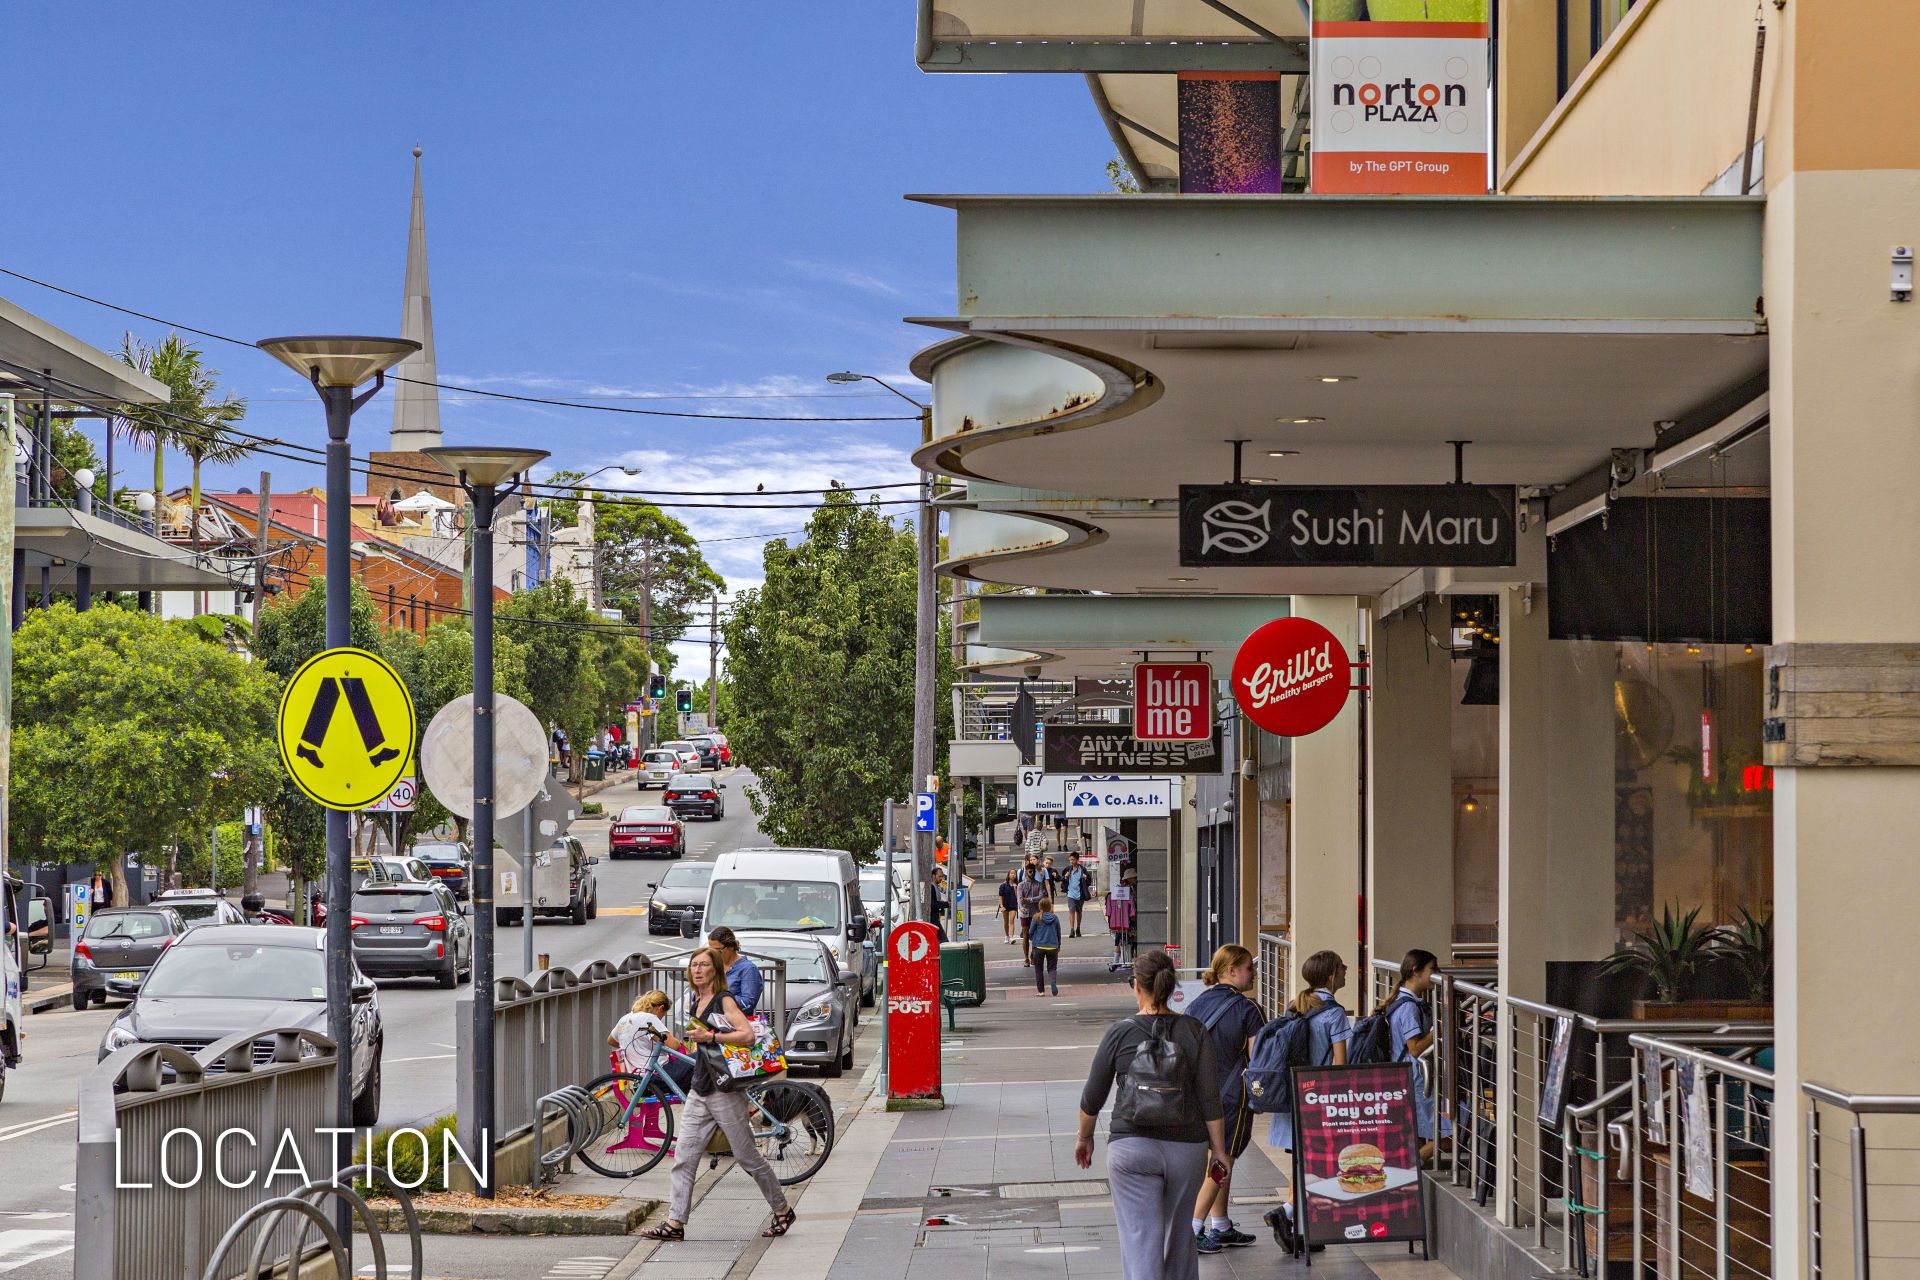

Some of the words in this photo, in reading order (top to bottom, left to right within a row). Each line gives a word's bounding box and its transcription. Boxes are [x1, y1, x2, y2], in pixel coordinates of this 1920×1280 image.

[1333, 78, 1466, 107] norton
[1365, 105, 1438, 122] PLAZA
[1350, 161, 1363, 174] by
[1365, 160, 1386, 171] The
[1389, 161, 1412, 172] GPT
[1415, 161, 1449, 174] Group
[1291, 508, 1384, 546] Sushi
[1399, 509, 1498, 546] Maru
[1242, 641, 1333, 709] Grill'd
[1147, 669, 1199, 706] bún
[1270, 686, 1301, 704] healthy
[1302, 672, 1334, 691] burgers
[1147, 708, 1192, 735] me
[1080, 753, 1186, 766] FITNESS
[1023, 771, 1043, 787] 67
[1067, 782, 1077, 791] 67
[393, 788, 410, 800] 40
[1104, 794, 1163, 806] Co.As.It.
[917, 796, 932, 817] P
[1035, 801, 1062, 809] Italian
[1108, 853, 1128, 862] open
[77, 886, 84, 896] P
[77, 916, 84, 924] P
[888, 1001, 932, 1014] POST
[1302, 1080, 1316, 1089] NEW
[1326, 1105, 1360, 1119] Day
[1364, 1103, 1388, 1115] off
